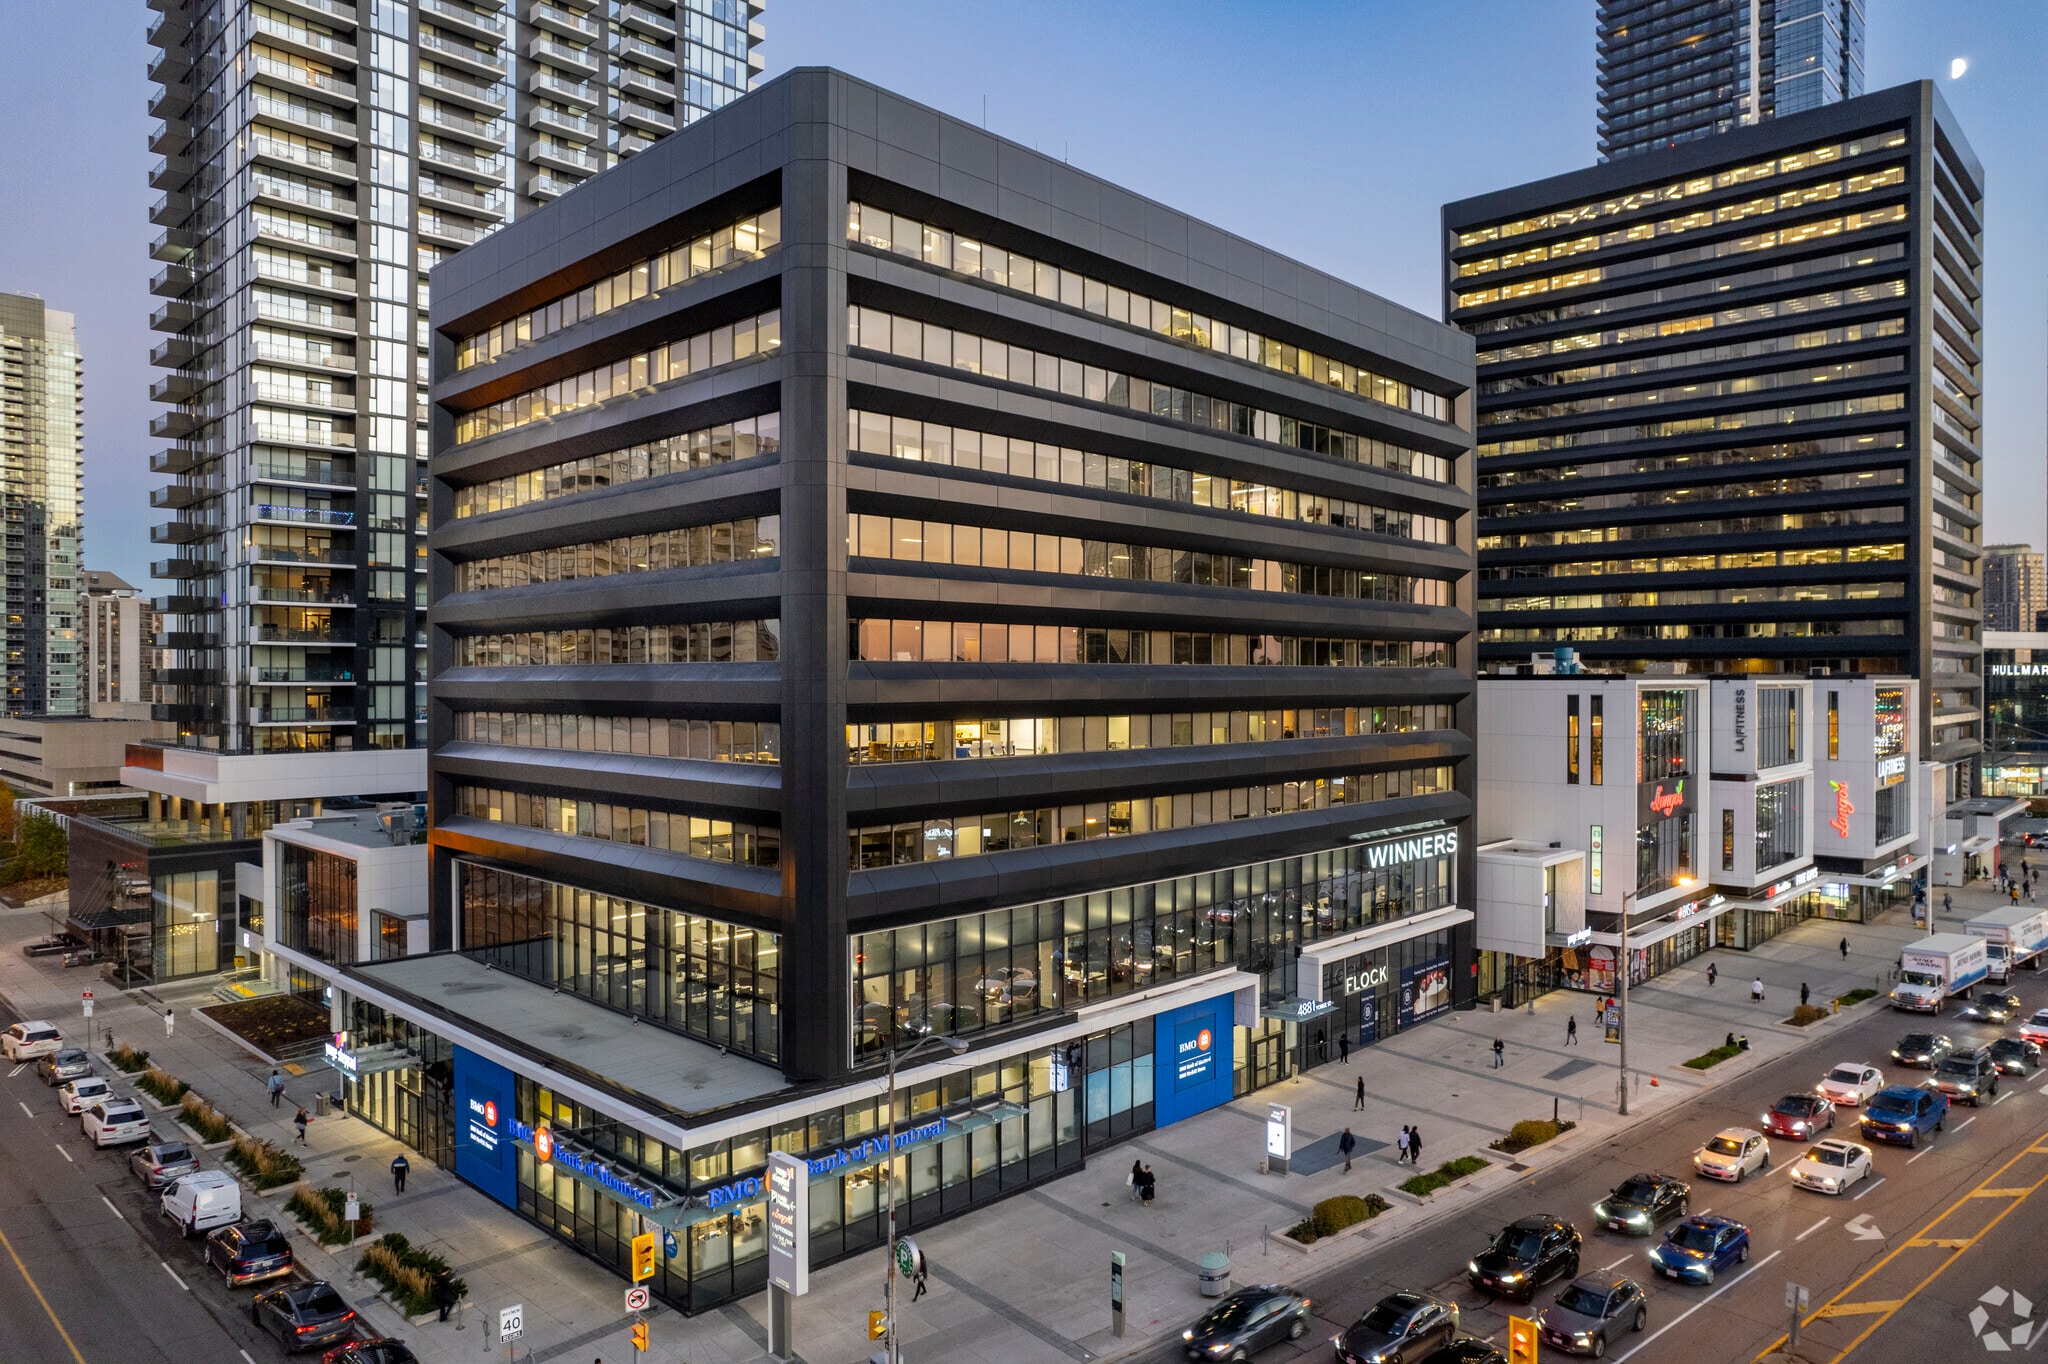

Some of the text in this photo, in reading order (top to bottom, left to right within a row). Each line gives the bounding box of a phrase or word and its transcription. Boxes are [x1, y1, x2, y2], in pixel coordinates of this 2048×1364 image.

[1992, 664, 2048, 676] HULLMAR
[1368, 832, 1457, 869] WINNERS
[1346, 965, 1387, 994] FLOCK
[1298, 1000, 1316, 1016] 4881
[1179, 1040, 1197, 1053] BMO
[470, 1099, 485, 1115] BMO
[508, 1118, 533, 1145] BMO
[554, 1141, 585, 1173] Bank
[584, 1161, 597, 1179] of
[597, 1165, 653, 1210] Montreal
[708, 1177, 760, 1209] BMO
[852, 1140, 871, 1161] of
[503, 1317, 520, 1331] 40
